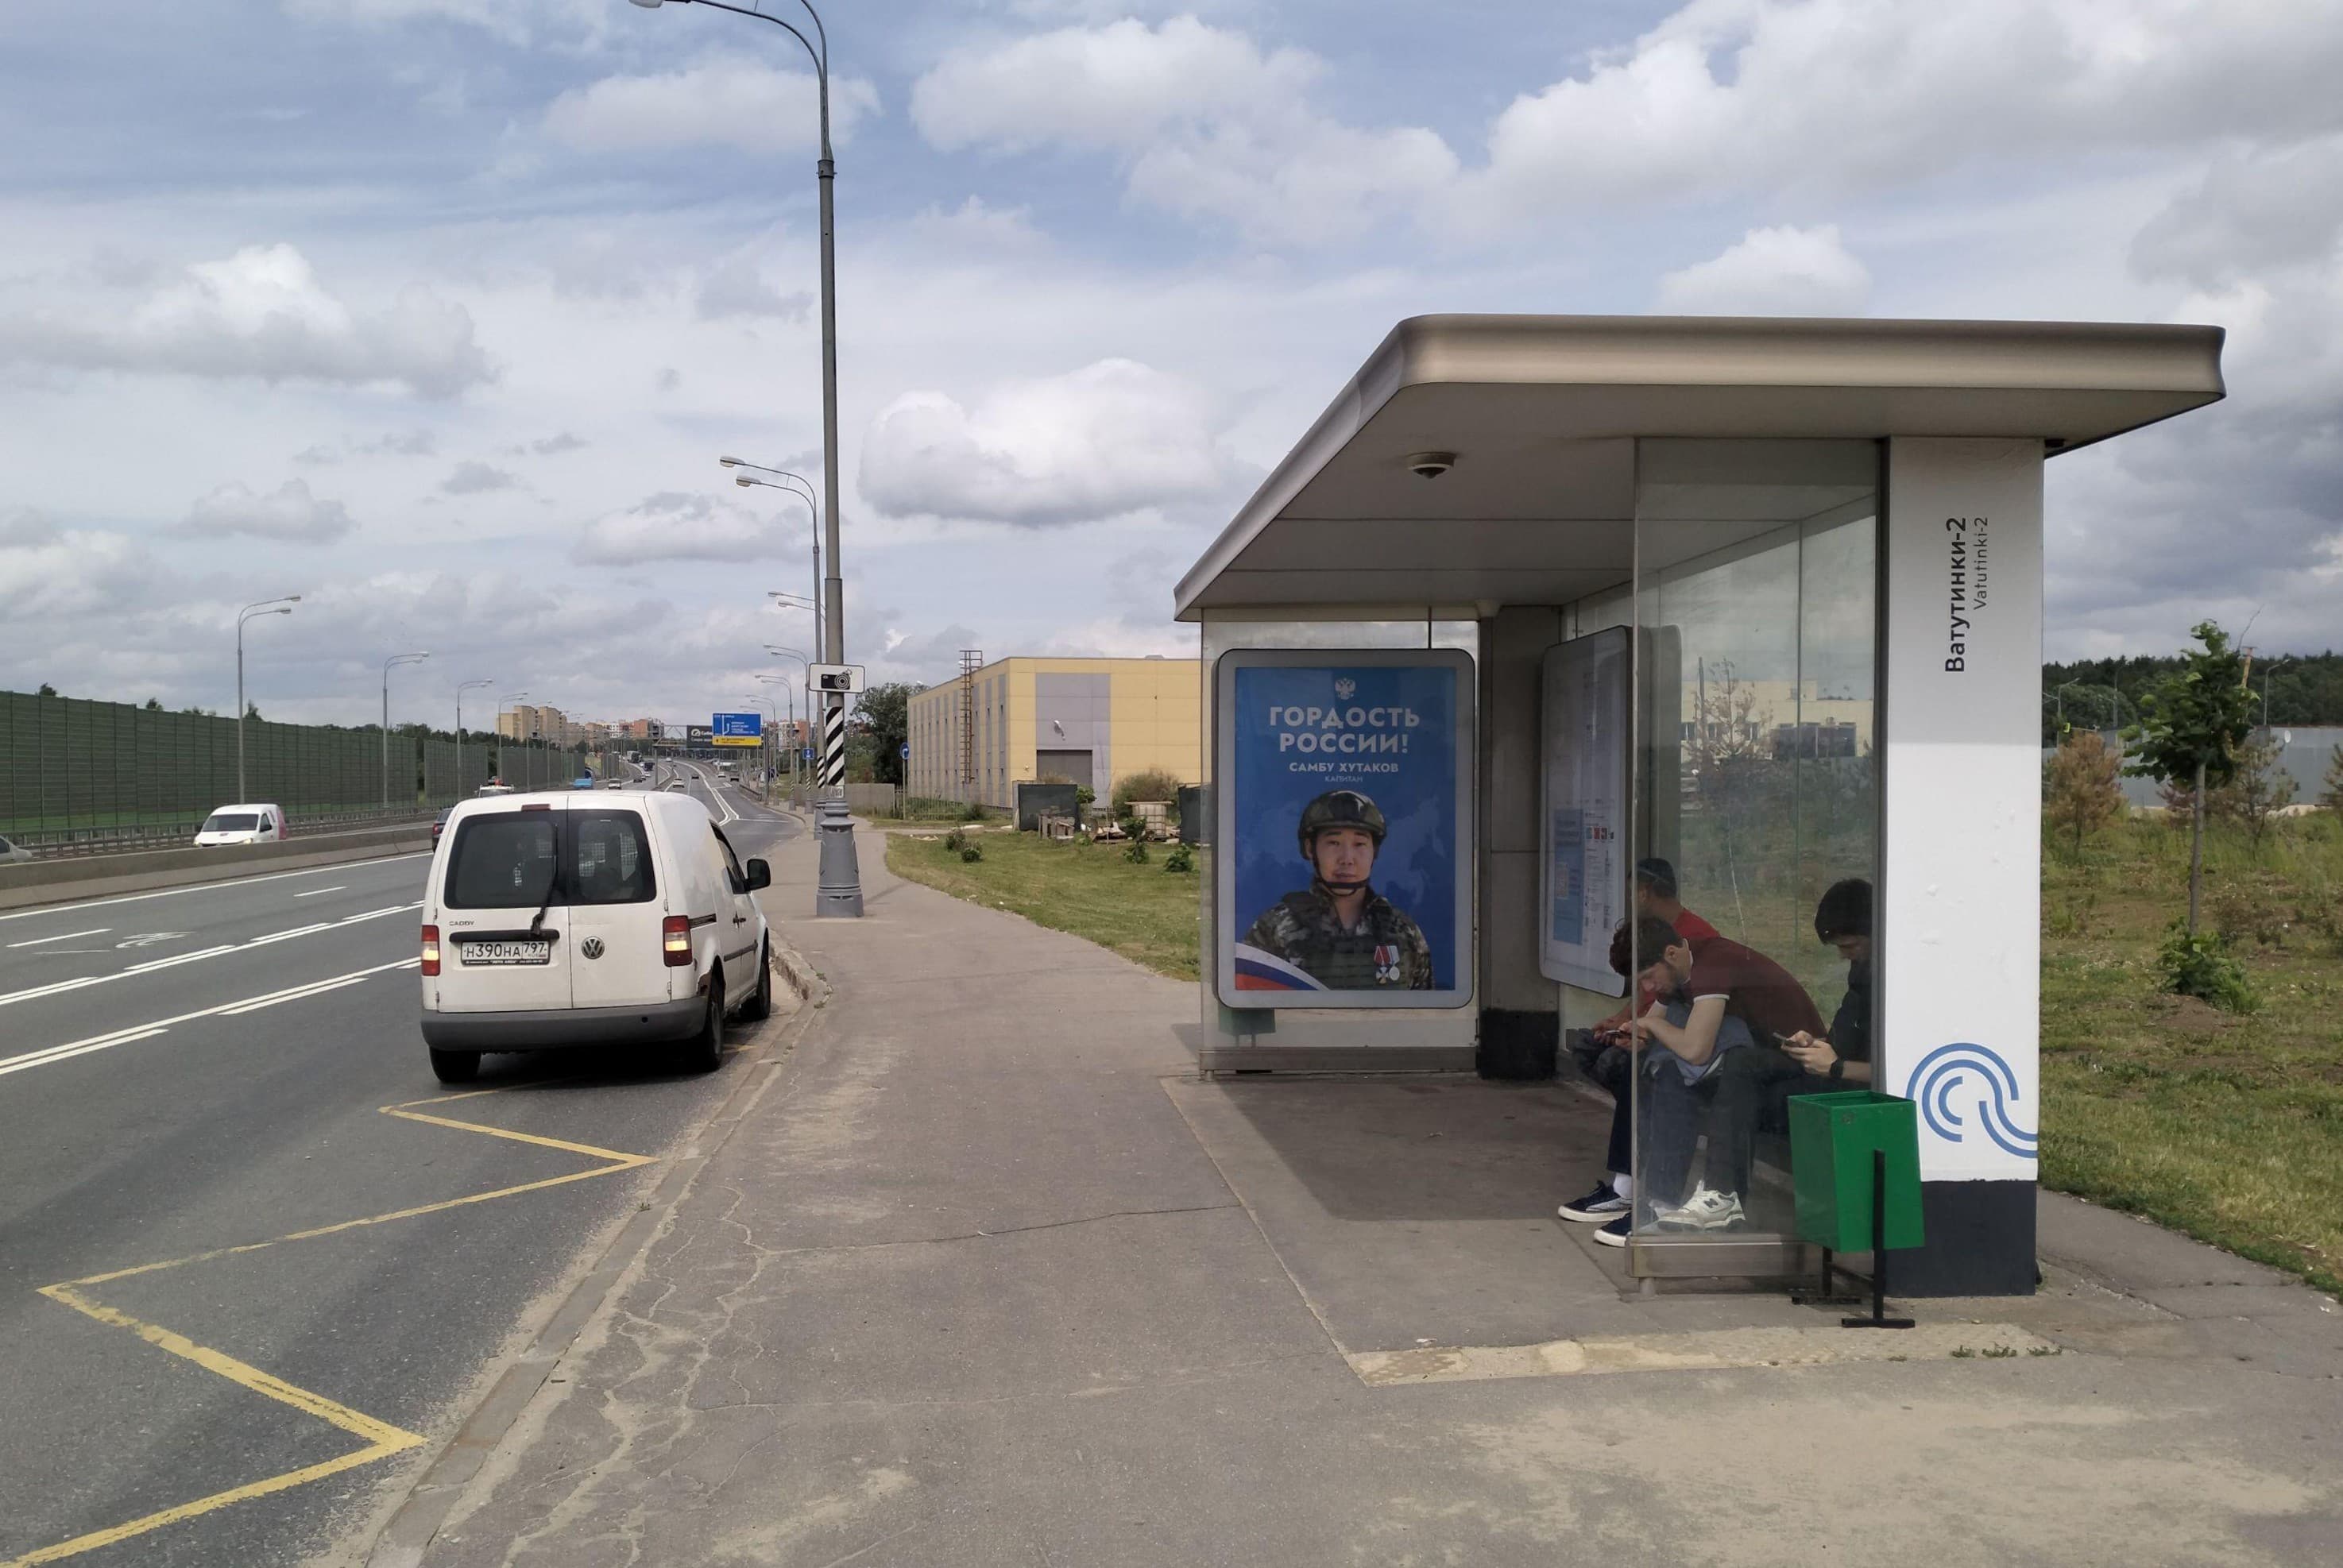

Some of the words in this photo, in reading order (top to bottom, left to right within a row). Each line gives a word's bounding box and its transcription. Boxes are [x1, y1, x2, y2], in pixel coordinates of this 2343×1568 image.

[1974, 517, 1988, 610] Vatutinki-2
[1945, 517, 1970, 672] Ватутинки-2
[1270, 706, 1421, 729] ГОРДОСТЬ
[1280, 732, 1409, 754] РОССИИ!
[1289, 762, 1335, 773] САМБУ
[1339, 763, 1399, 773] ХУТАКОВ
[524, 942, 545, 953] 797
